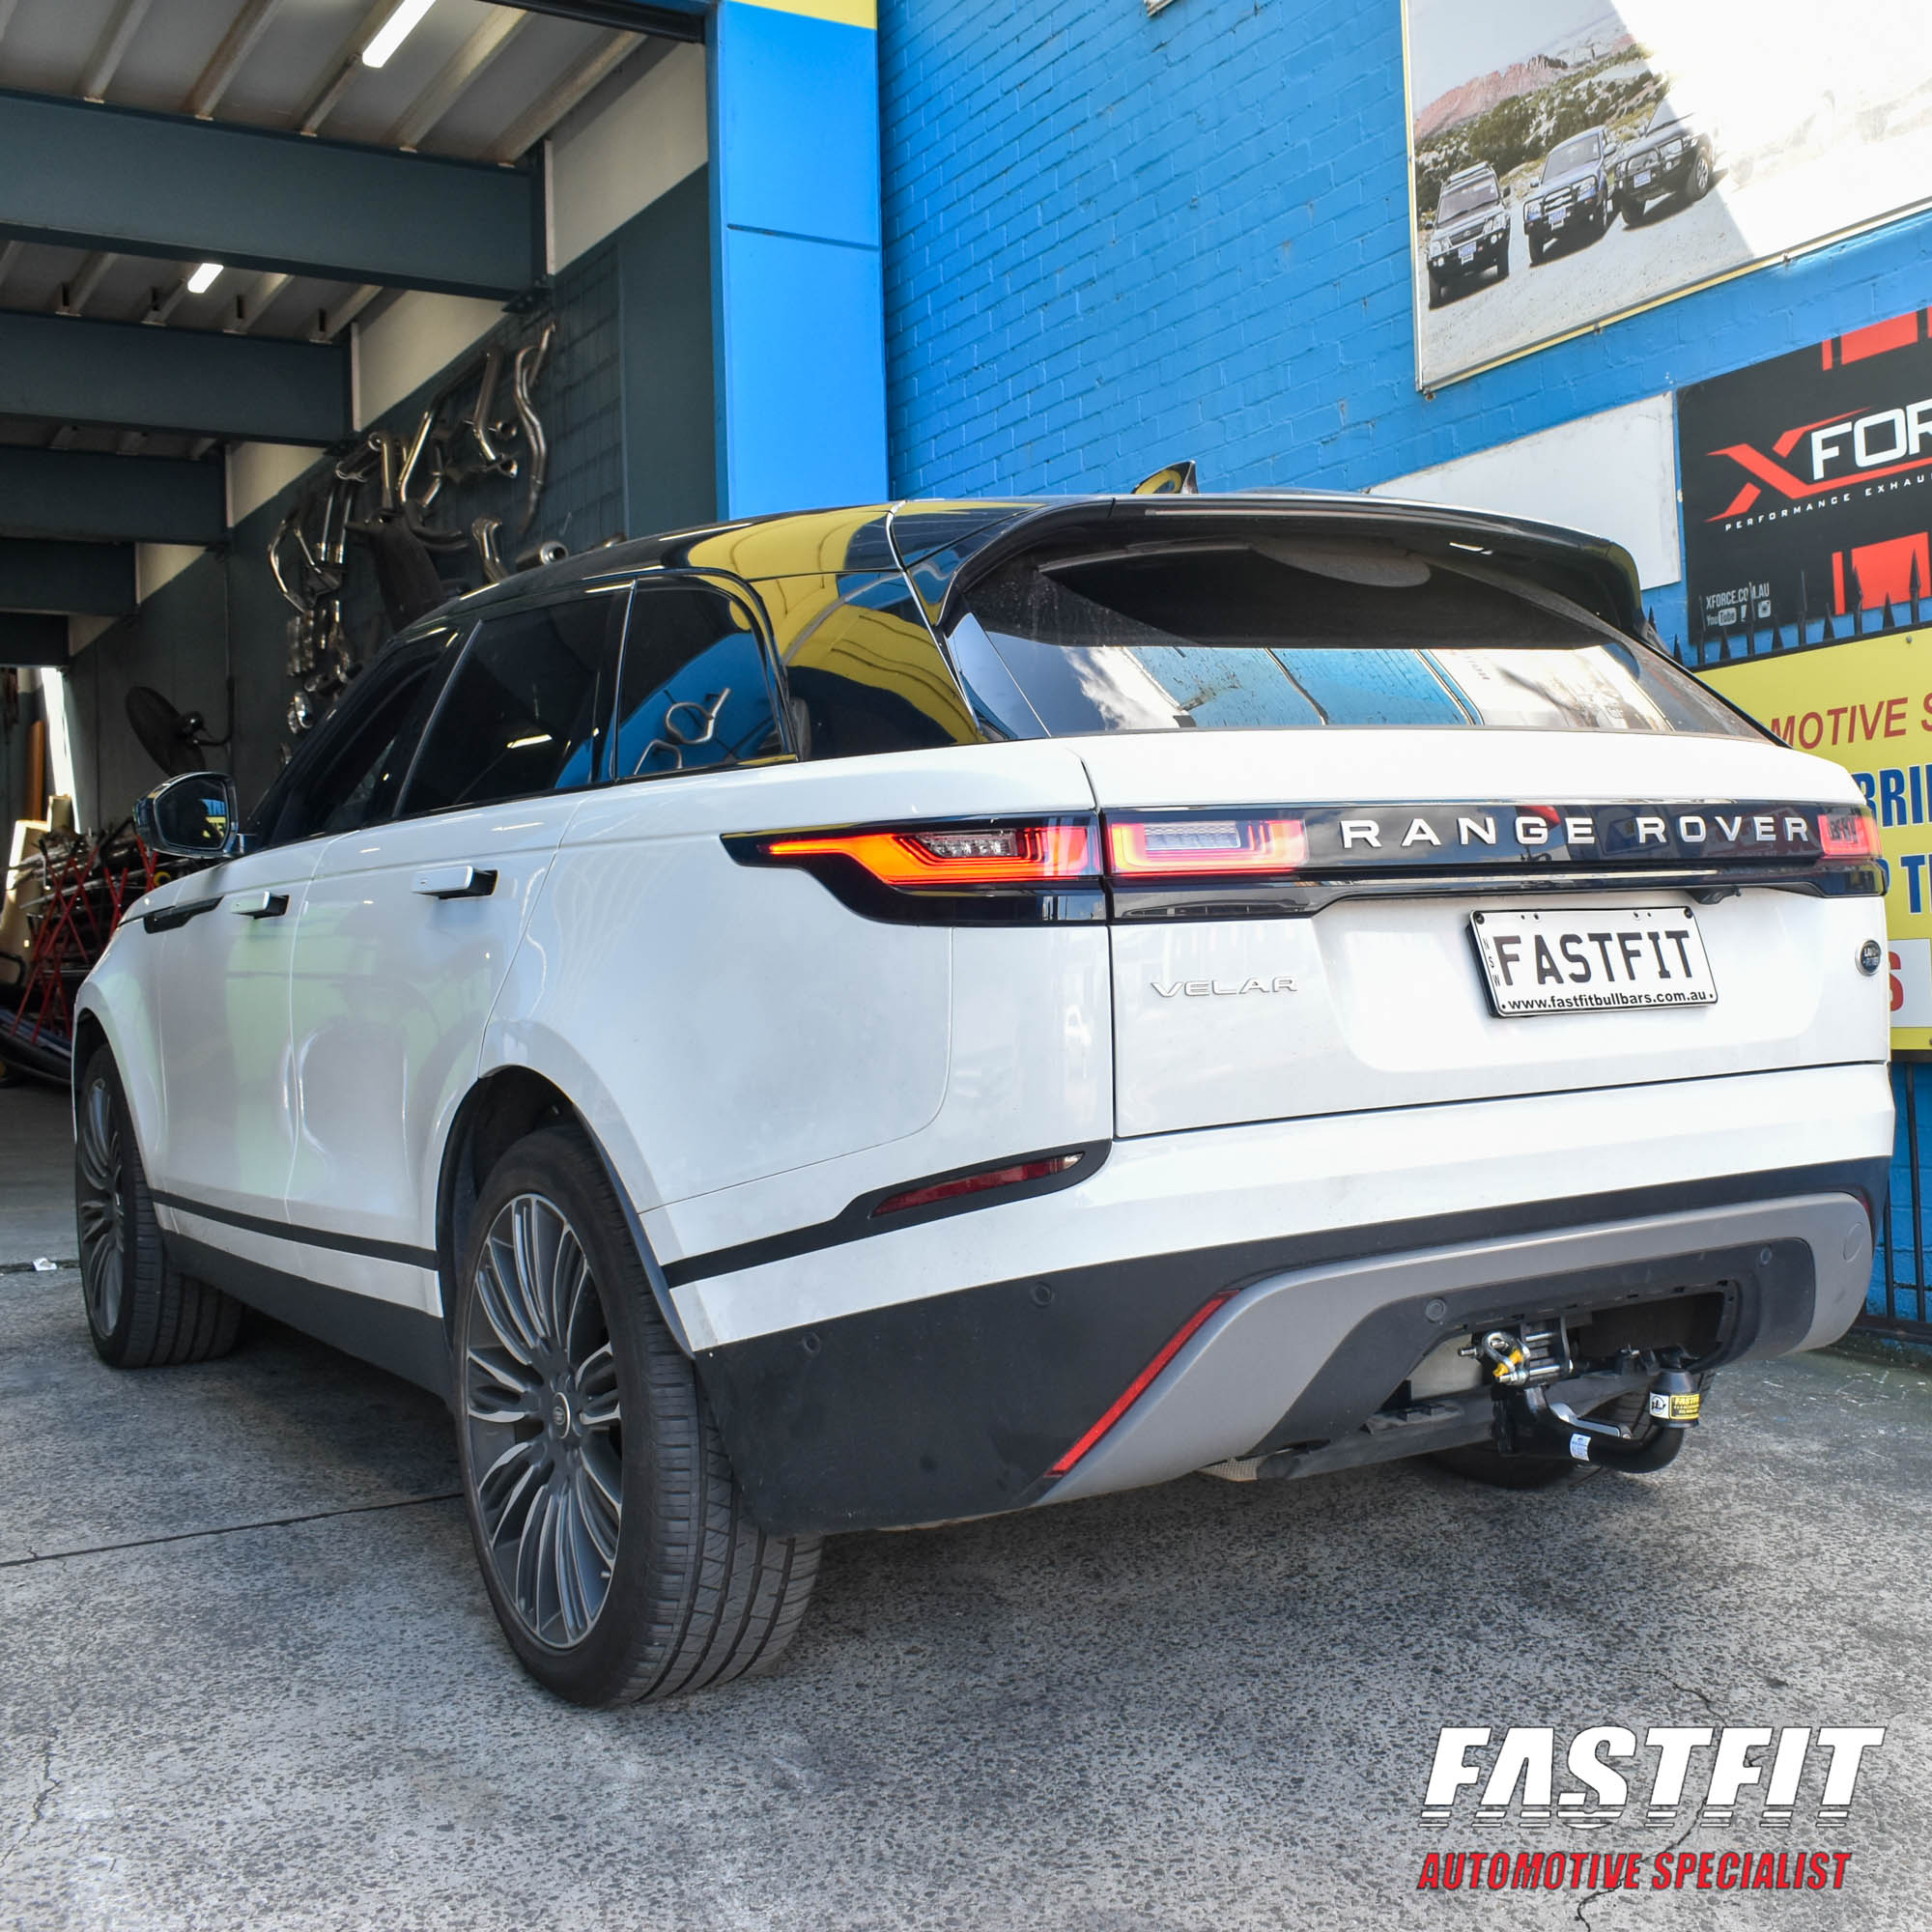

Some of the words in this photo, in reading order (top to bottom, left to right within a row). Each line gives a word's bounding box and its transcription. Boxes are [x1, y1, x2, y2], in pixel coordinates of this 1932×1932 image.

[1725, 493, 1851, 531] PERFORMANCE
[1865, 472, 1932, 497] EXHAU
[1340, 816, 1596, 849] RANGE
[1635, 815, 1809, 843] ROVER
[1492, 929, 1693, 987] FASTFIT
[1151, 976, 1298, 999] VELAR
[1508, 990, 1707, 1010] www.fastfitbullbars.com.au
